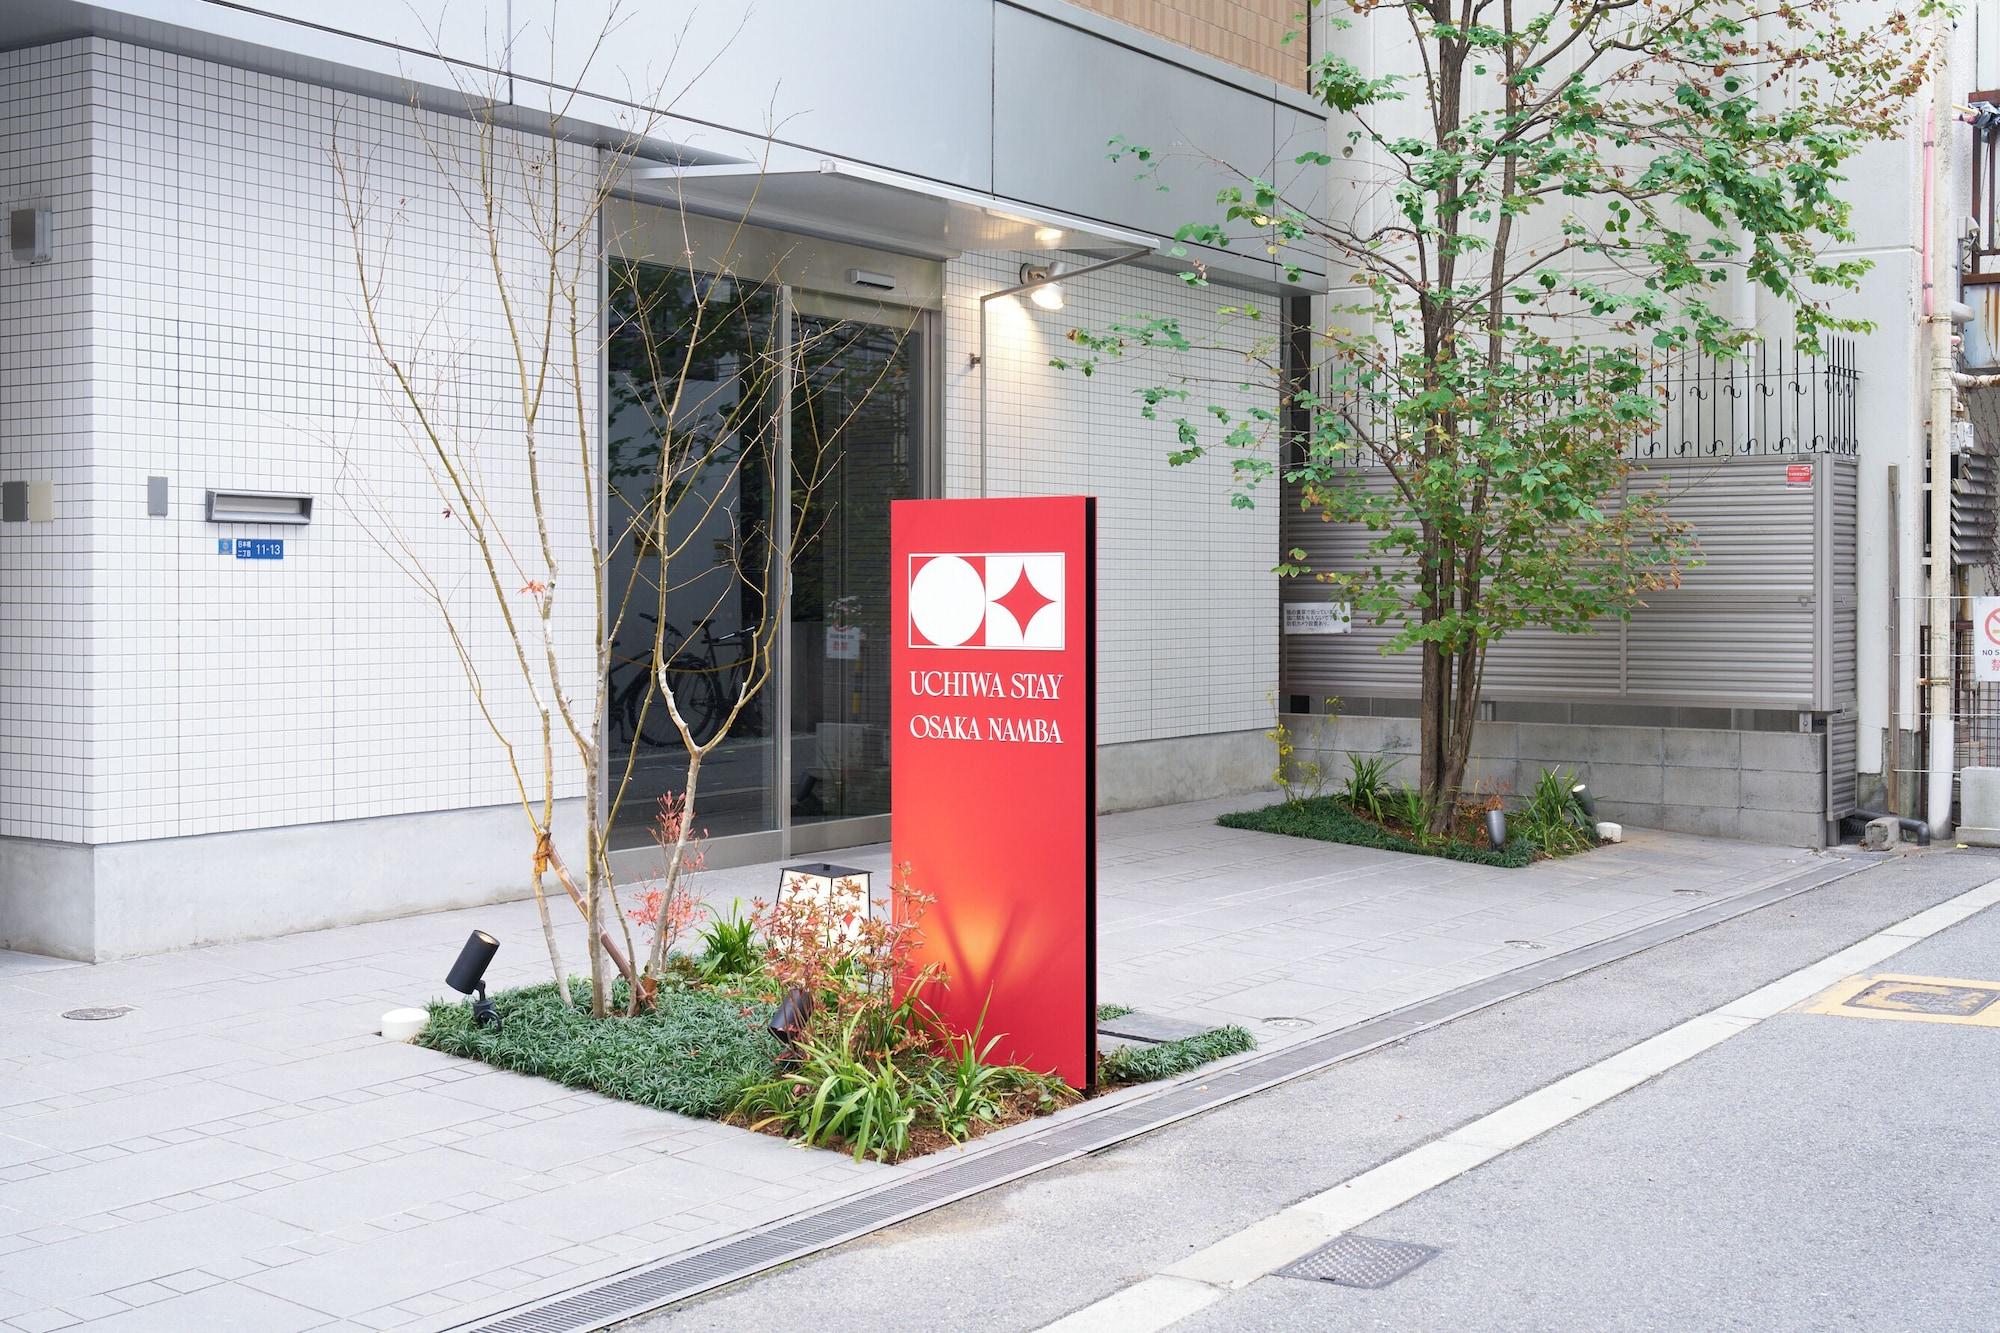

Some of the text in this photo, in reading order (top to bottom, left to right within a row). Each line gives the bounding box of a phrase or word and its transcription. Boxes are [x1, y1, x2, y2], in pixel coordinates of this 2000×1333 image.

[256, 544, 280, 555] 11-13
[910, 671, 1063, 700] UCHIWA STAY
[910, 714, 1064, 744] OSAKA NAMBA
